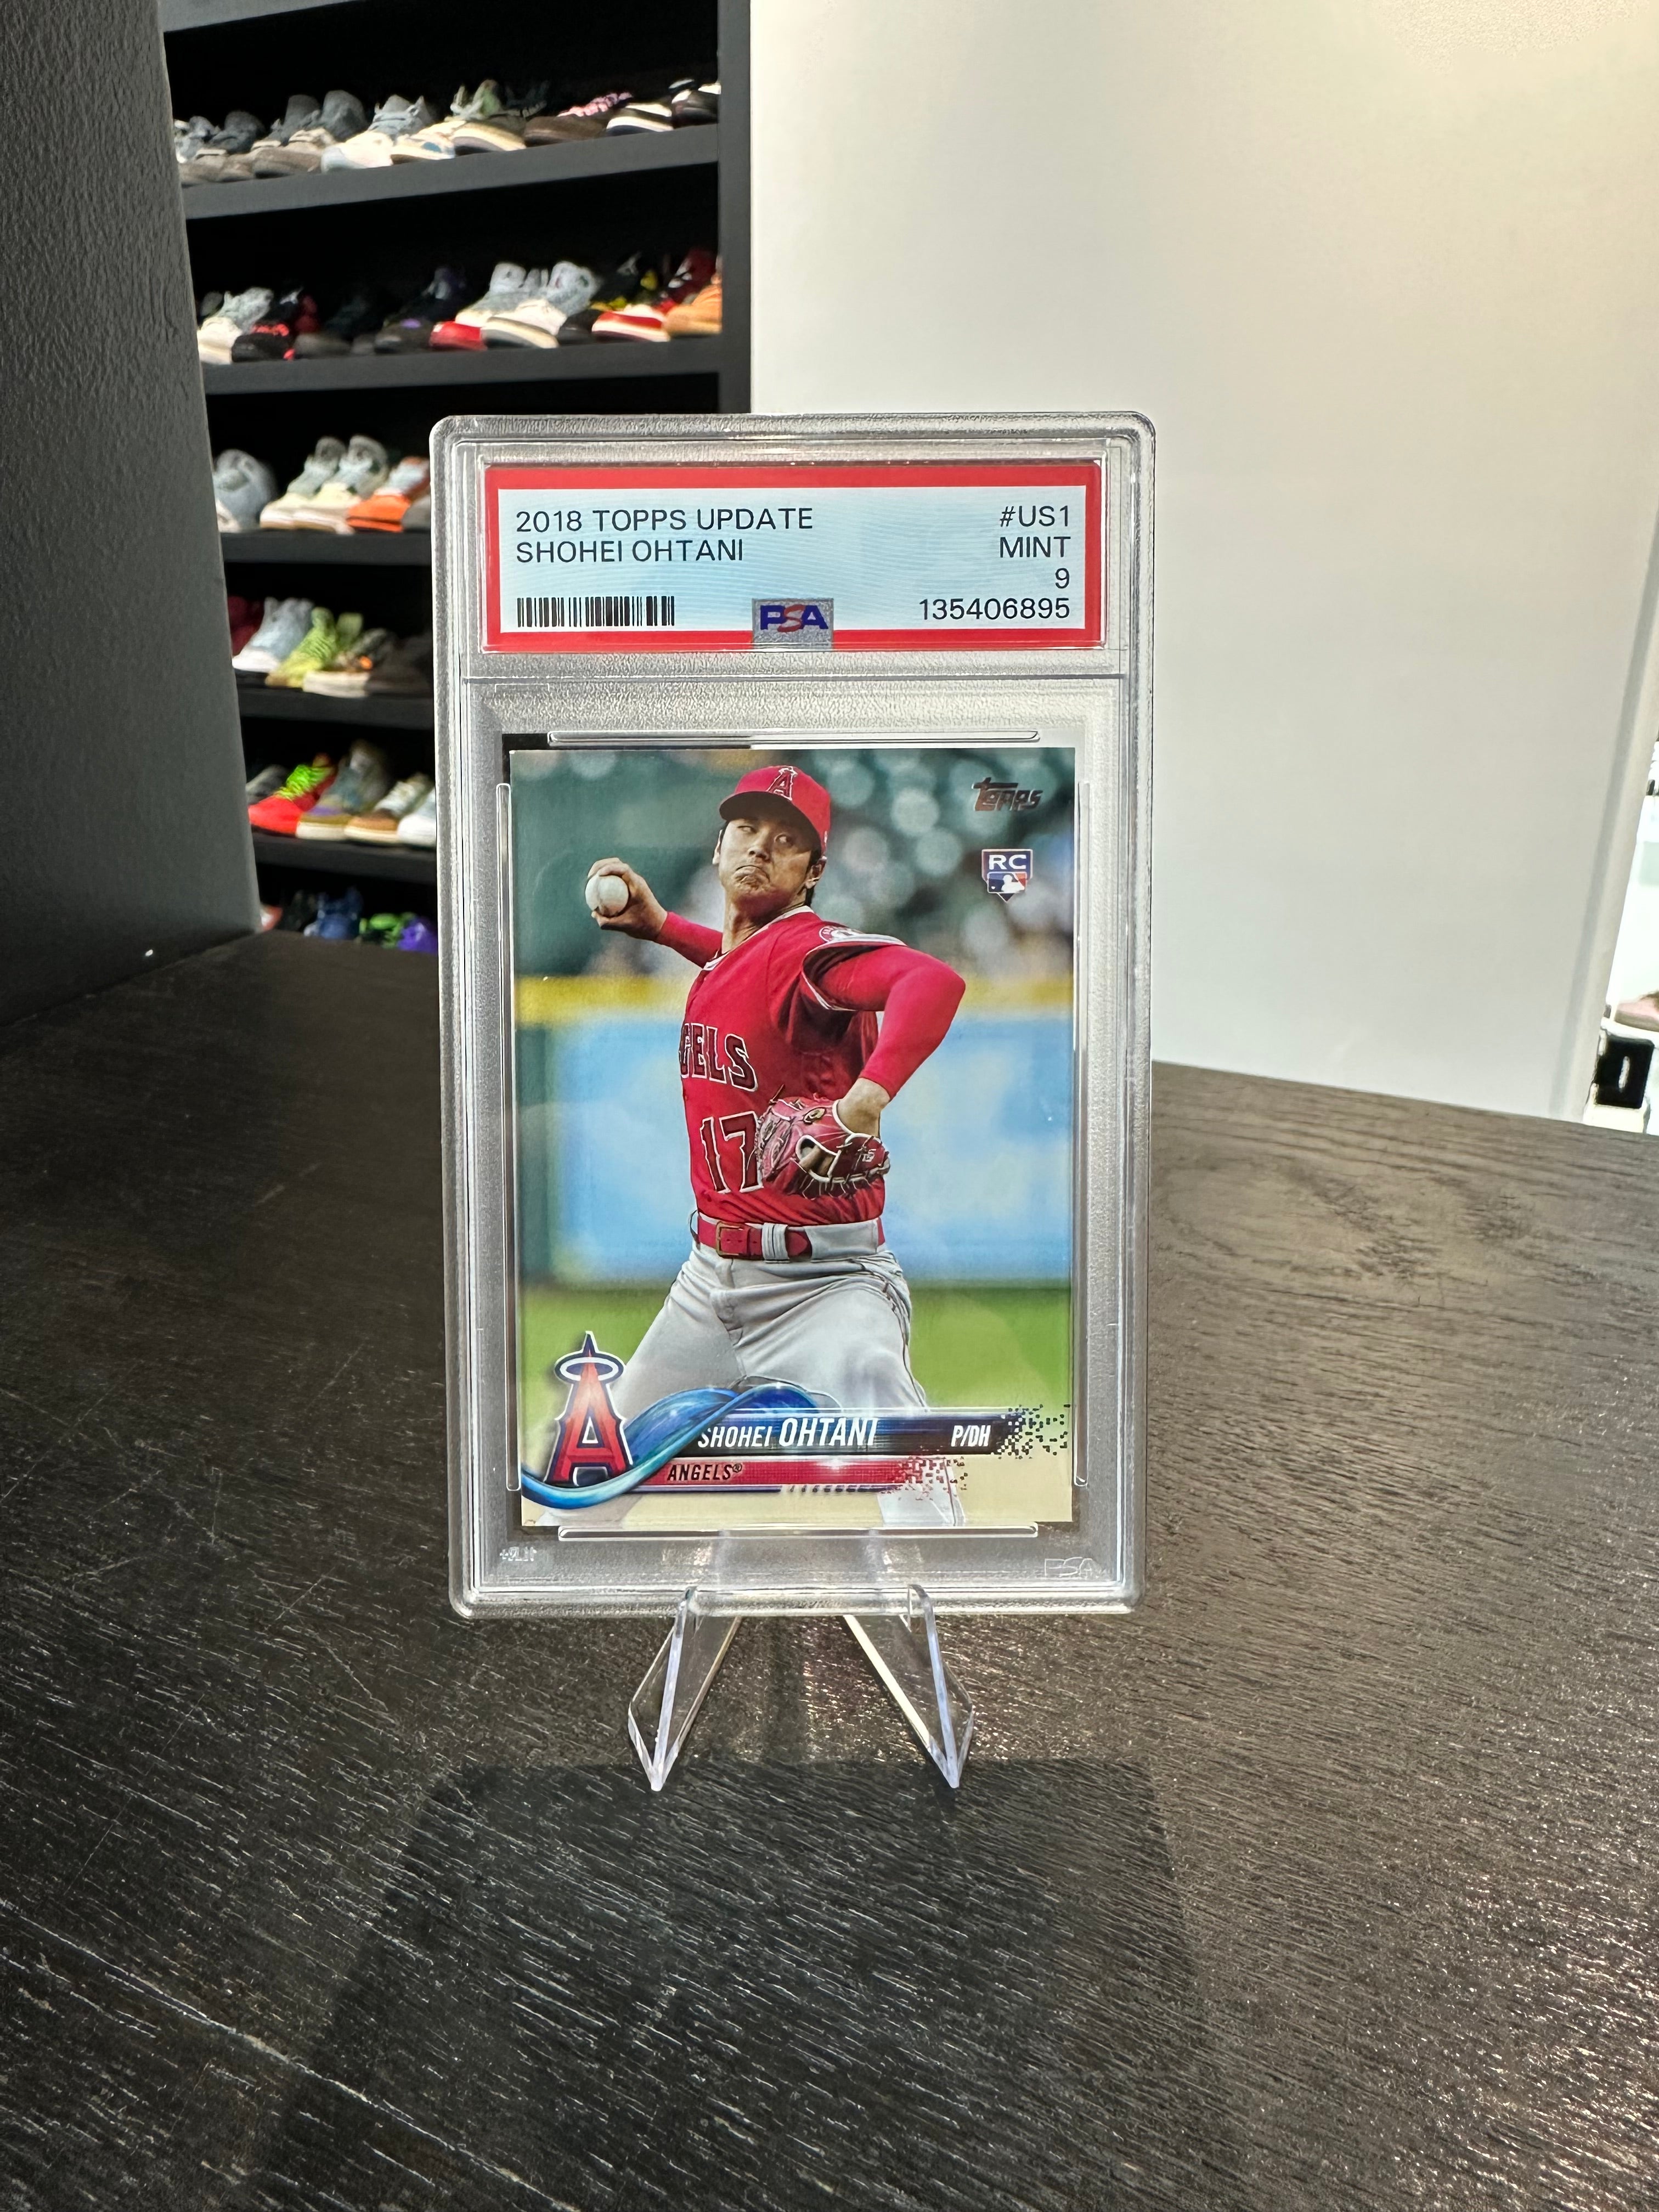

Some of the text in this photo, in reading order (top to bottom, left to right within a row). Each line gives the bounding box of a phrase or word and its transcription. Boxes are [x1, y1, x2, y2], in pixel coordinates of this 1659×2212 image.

[517, 507, 814, 532] 2018 TOPPS UPDATE
[1000, 505, 1070, 527] #US1
[516, 539, 743, 563] SHOHEI OHTANI
[1000, 536, 1071, 558] MINT
[1055, 567, 1070, 589] 9
[760, 604, 828, 632] PSA
[919, 597, 1070, 620] 135406895
[989, 854, 1027, 870] RC
[699, 1110, 764, 1194] 17
[697, 1417, 878, 1448] SHOHEI OHTANI
[951, 1425, 991, 1447] P/DH
